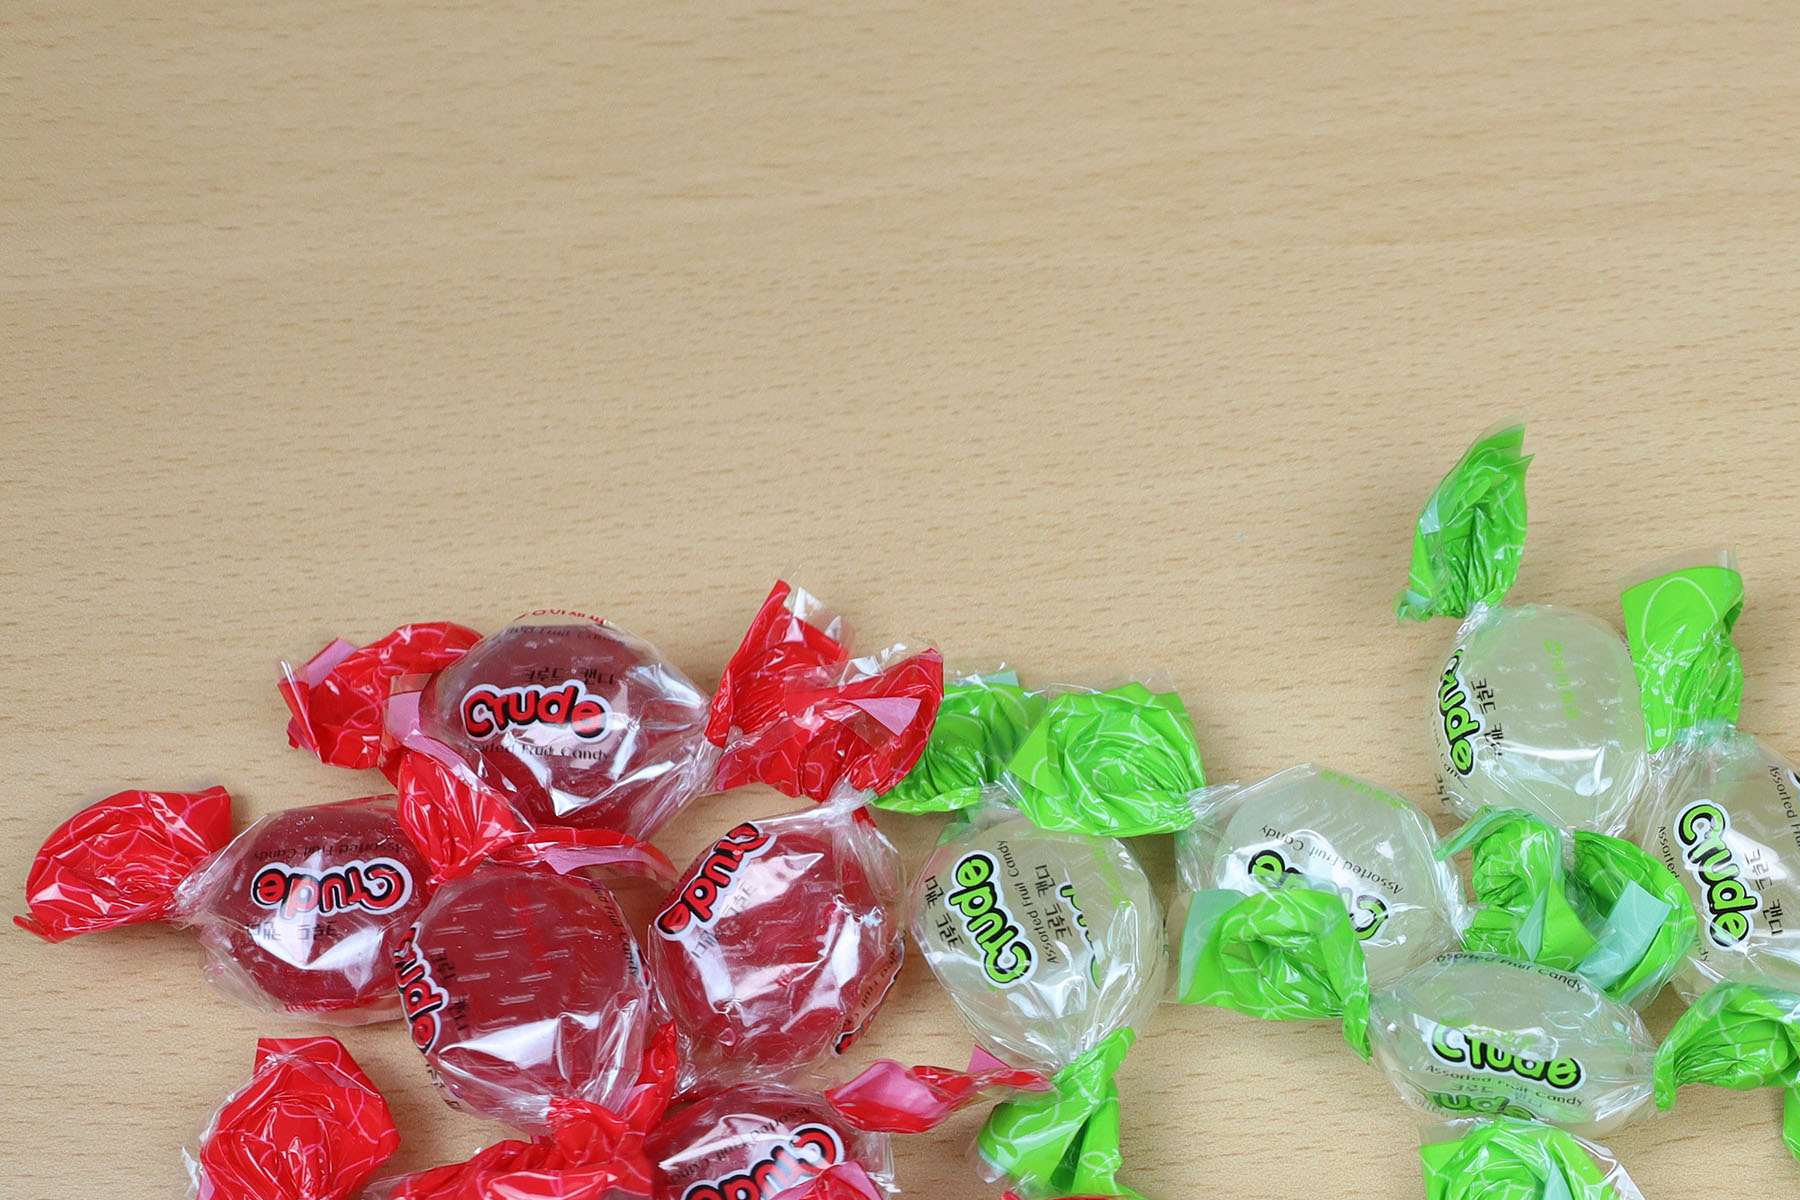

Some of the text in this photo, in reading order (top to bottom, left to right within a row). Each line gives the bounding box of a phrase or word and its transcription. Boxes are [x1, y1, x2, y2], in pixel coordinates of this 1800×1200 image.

[464, 685, 607, 739] Crude
[1470, 677, 1497, 715] 크루드
[1767, 764, 1799, 822] Assorted
[254, 863, 403, 920] Crude
[657, 821, 771, 935] Crude
[1260, 823, 1405, 896] Assorted Fruit Candy
[1678, 803, 1758, 947] Crude
[1744, 848, 1784, 936] 크루드 캔디
[923, 875, 965, 952] 크루드 캔디
[948, 853, 1031, 985] Crude
[996, 839, 1061, 965] Assorted Fruit Candy
[1034, 863, 1074, 941] 크루드 캔디
[1499, 957, 1532, 971] Fruit
[1536, 966, 1585, 993] Candy
[1425, 1064, 1492, 1083] Assorted
[1534, 1089, 1585, 1108] Candy
